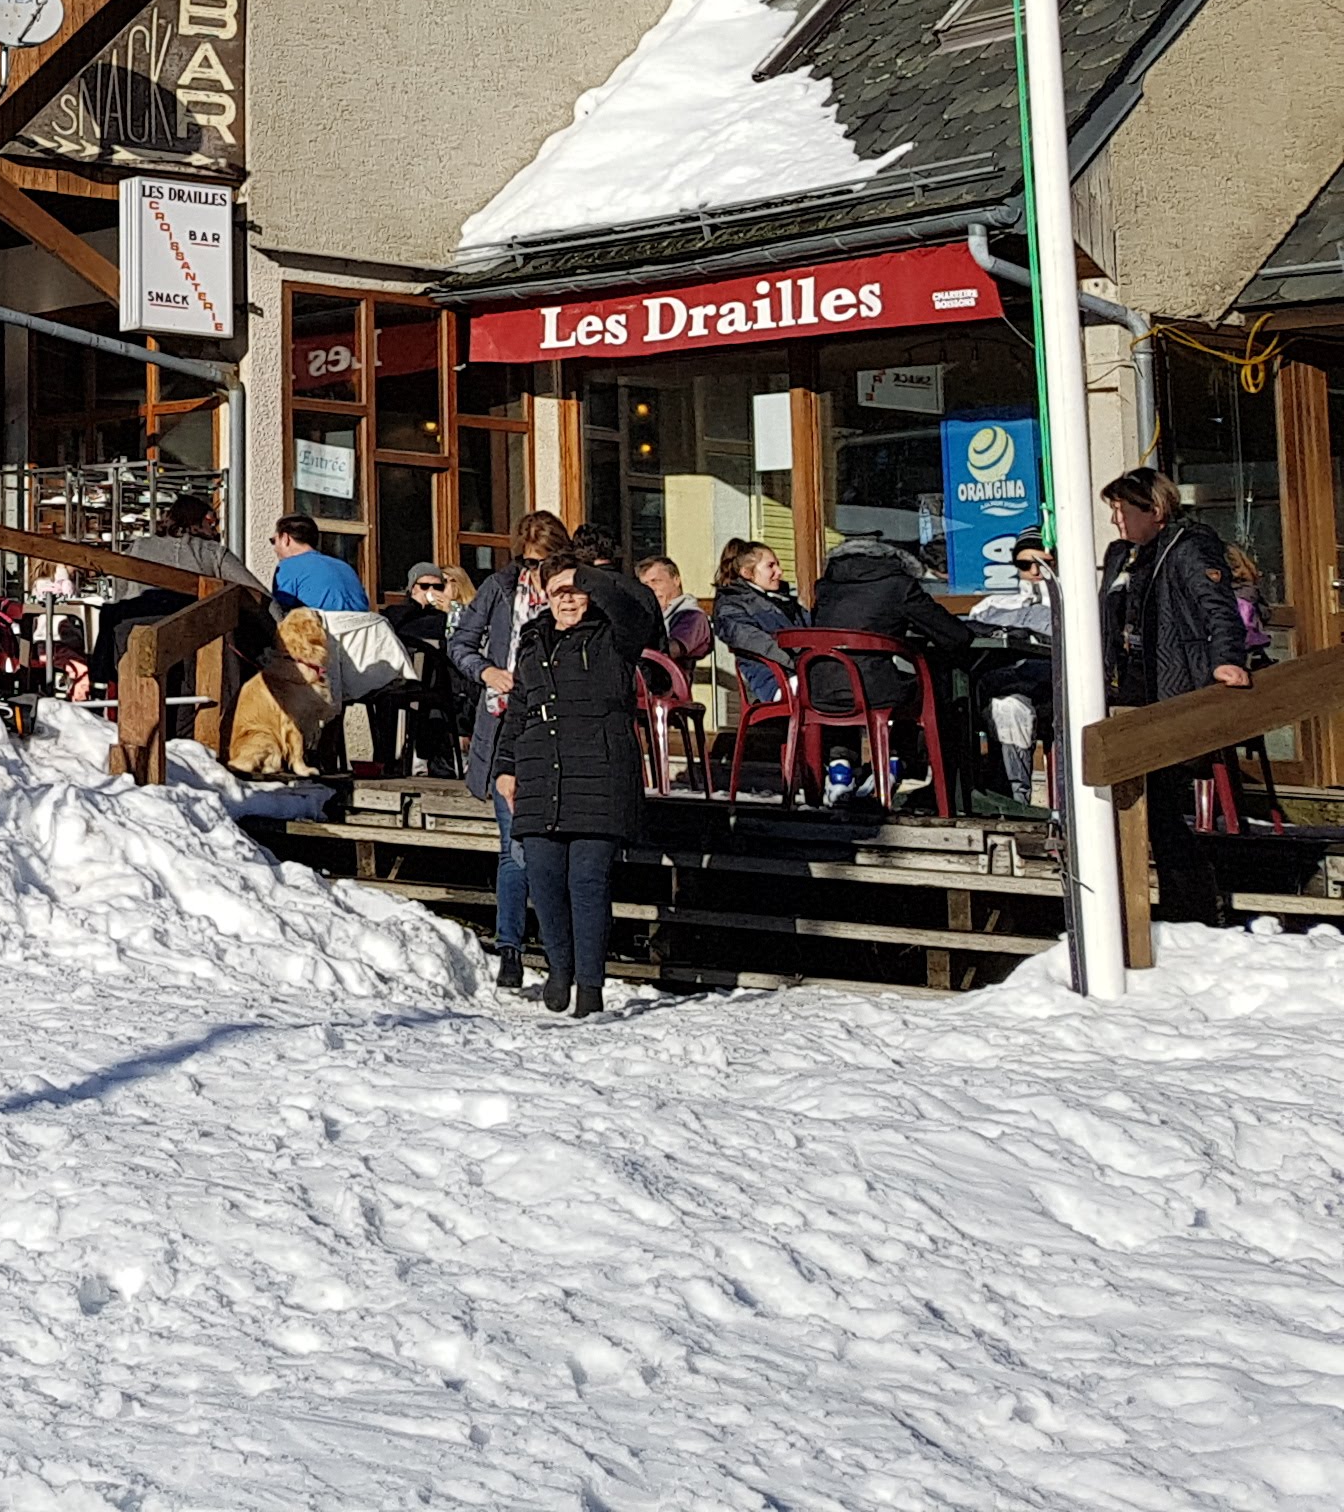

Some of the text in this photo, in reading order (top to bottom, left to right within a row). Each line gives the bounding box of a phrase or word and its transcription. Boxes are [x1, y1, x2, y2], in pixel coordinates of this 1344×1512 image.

[51, 6, 175, 148] SNACK
[141, 184, 228, 207] LES DRAILLES
[188, 230, 221, 244] BAR
[148, 200, 224, 332] CROISSANTERIE
[147, 291, 190, 306] SNACK
[539, 276, 883, 350] Les Drailles
[298, 449, 347, 473] Entrée
[957, 476, 1026, 502] ORANGINA
